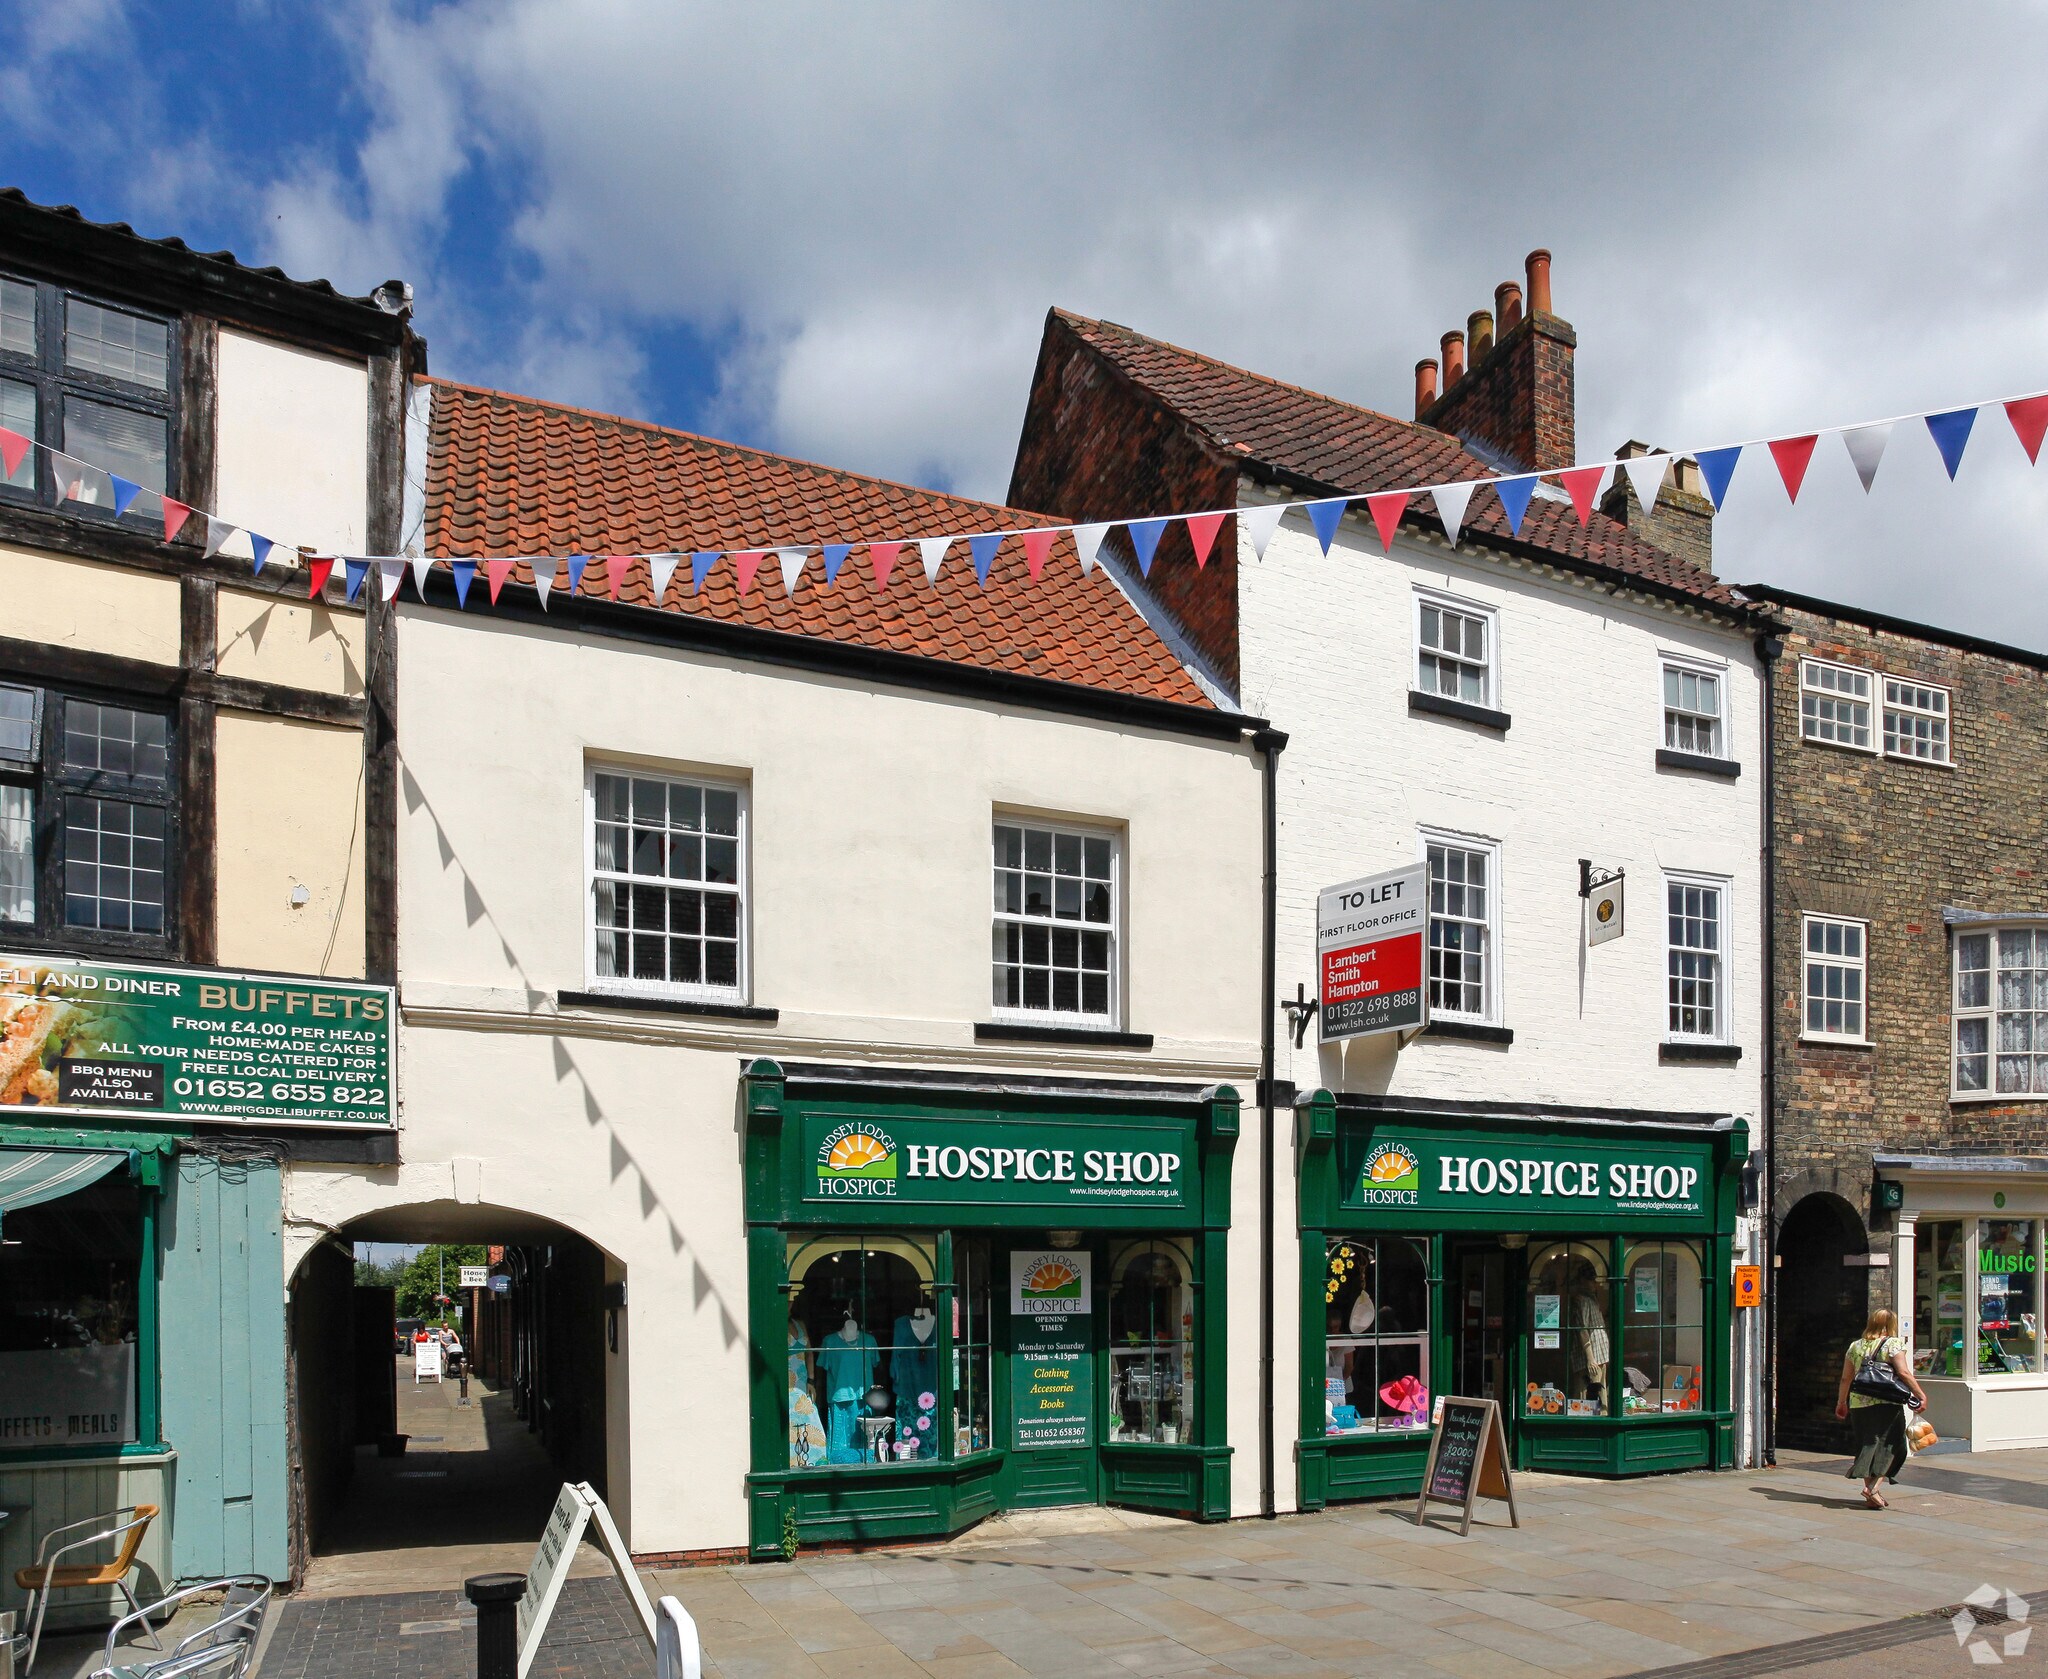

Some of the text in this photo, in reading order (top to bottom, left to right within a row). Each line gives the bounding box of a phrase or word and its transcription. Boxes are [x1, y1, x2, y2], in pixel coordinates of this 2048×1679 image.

[1339, 881, 1405, 911] TO LET
[1320, 909, 1417, 939] FIRST FLOOR OFFICE
[1328, 949, 1376, 969] Lambert
[42, 972, 98, 990] AND
[105, 977, 181, 997] DINER
[1328, 967, 1360, 984] Smith
[1328, 980, 1379, 998] Hampton
[199, 984, 385, 1021] BUFFETS
[1328, 991, 1417, 1020] 01522 698 888
[172, 1016, 376, 1042] FROM £4.00 PER HEAD
[1327, 1013, 1390, 1032] www.lsh.co.uk
[209, 1035, 376, 1055] HOME-MADE CAKES
[98, 1041, 377, 1069] ALL YOUR NEEDS CATERED FOR
[71, 1065, 153, 1078] BBQ MENU
[181, 1062, 377, 1083] FREE LOCAL DELIVERY
[92, 1078, 133, 1088] ALSO
[173, 1078, 386, 1105] 01652 655 822
[70, 1088, 154, 1101] AVAILABLE
[180, 1102, 387, 1120] WWW.BRIGGDELIBUFFET.CO.UK
[817, 1121, 897, 1164] LINDSEY LODGE
[906, 1144, 1181, 1184] HOSPICE SHOP
[1362, 1142, 1419, 1178] LINDSEY LODGE
[1438, 1155, 1698, 1199] HOSPICE SHOP
[818, 1177, 897, 1196] HOSPICE
[1069, 1187, 1179, 1197] www.lindseylodgehospice.org.uk
[1363, 1189, 1418, 1205] HOSPICE
[1616, 1201, 1699, 1211] www.lindseylodgehospice.org.uk
[1979, 1249, 2036, 1273] Music
[464, 1270, 487, 1279] Honey
[1022, 1253, 1081, 1288] LINDSEY LODGE
[1982, 1276, 2000, 1284] STAND
[1022, 1298, 1081, 1312] HOSPICE
[1040, 1324, 1063, 1332] TIMES
[1018, 1343, 1045, 1351] Monday
[1055, 1342, 1085, 1351] Saturday
[1054, 1353, 1079, 1361] 4.15pm
[1034, 1368, 1069, 1379] Clothing
[1030, 1383, 1074, 1394] Accessories
[1040, 1399, 1065, 1409] Books
[68, 1414, 118, 1438] MEALS
[1018, 1417, 1045, 1425] Donations
[1064, 1415, 1086, 1423] welcome
[1019, 1427, 1085, 1439] Tel: 01652 658367
[1443, 1443, 1474, 1458] £2000
